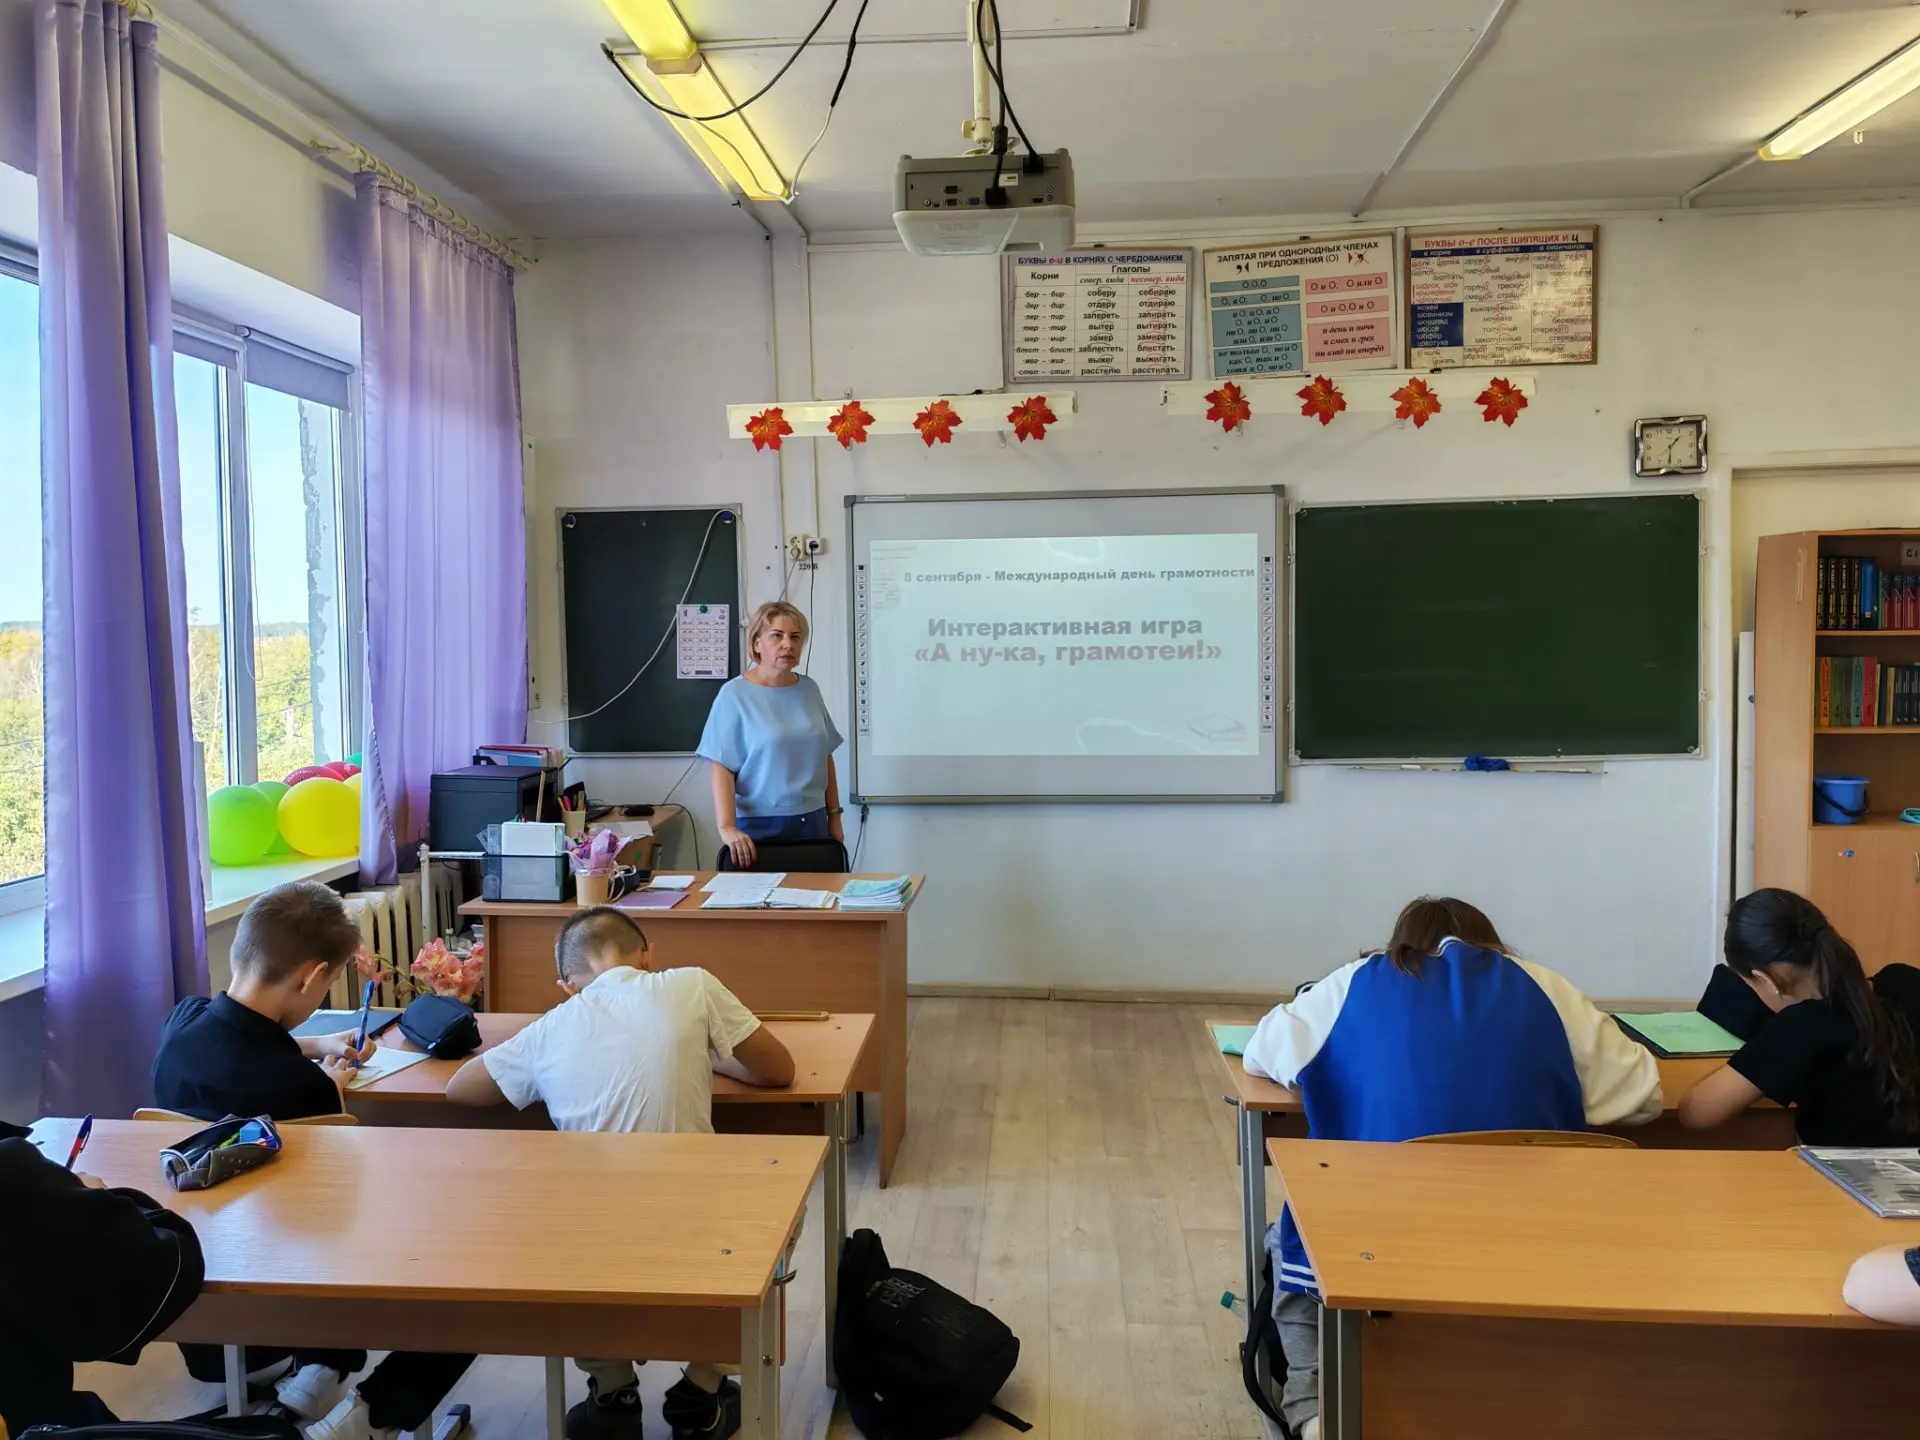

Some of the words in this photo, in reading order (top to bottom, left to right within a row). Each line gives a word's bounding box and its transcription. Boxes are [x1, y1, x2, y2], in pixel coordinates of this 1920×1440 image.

[1477, 237, 1508, 245] ПОСЛЕ
[1511, 235, 1560, 244] ШИПЯЩИХ
[1217, 253, 1256, 262] ЗАПЯТАЯ
[1278, 245, 1341, 257] ОДНОРОДНЫХ
[1343, 242, 1379, 251] ЧЛЕНАХ
[1116, 255, 1183, 263] ЧЕРЕДОВАНИЕМ
[1257, 256, 1323, 268] ПРЕДЛОЖЕНИЯ
[1031, 272, 1059, 281] Корни
[1139, 288, 1176, 296] собираю
[916, 572, 982, 583] сентября
[995, 569, 1116, 583] Международный
[1121, 571, 1156, 581] день
[1161, 568, 1255, 581] грамотности
[928, 618, 1131, 640] Интерактивная
[1141, 620, 1202, 638] игра
[915, 642, 950, 662] «А
[960, 646, 1045, 667] ну-ка,
[1056, 640, 1221, 666] грамотеи!»
